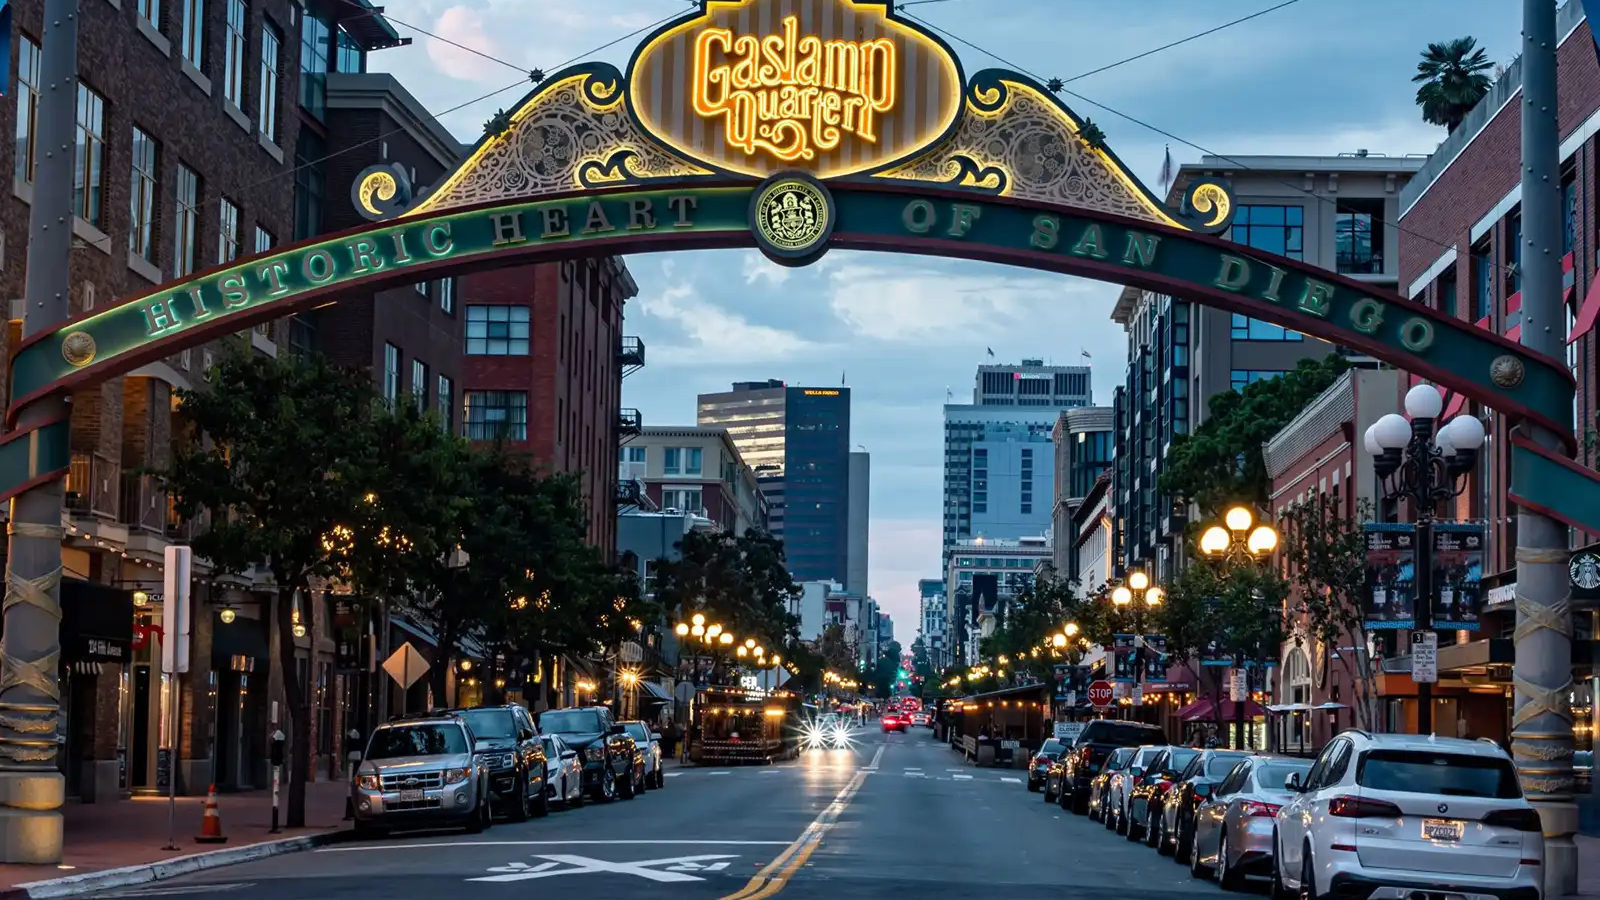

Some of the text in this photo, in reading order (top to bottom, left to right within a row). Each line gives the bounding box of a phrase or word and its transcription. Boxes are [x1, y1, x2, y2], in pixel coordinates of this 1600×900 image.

[693, 13, 896, 117] Gaslamp
[725, 84, 877, 160] Quarter
[140, 195, 1434, 352] HISTORIC HEART OF SAN DIEGO
[1090, 689, 1112, 698] STOP
